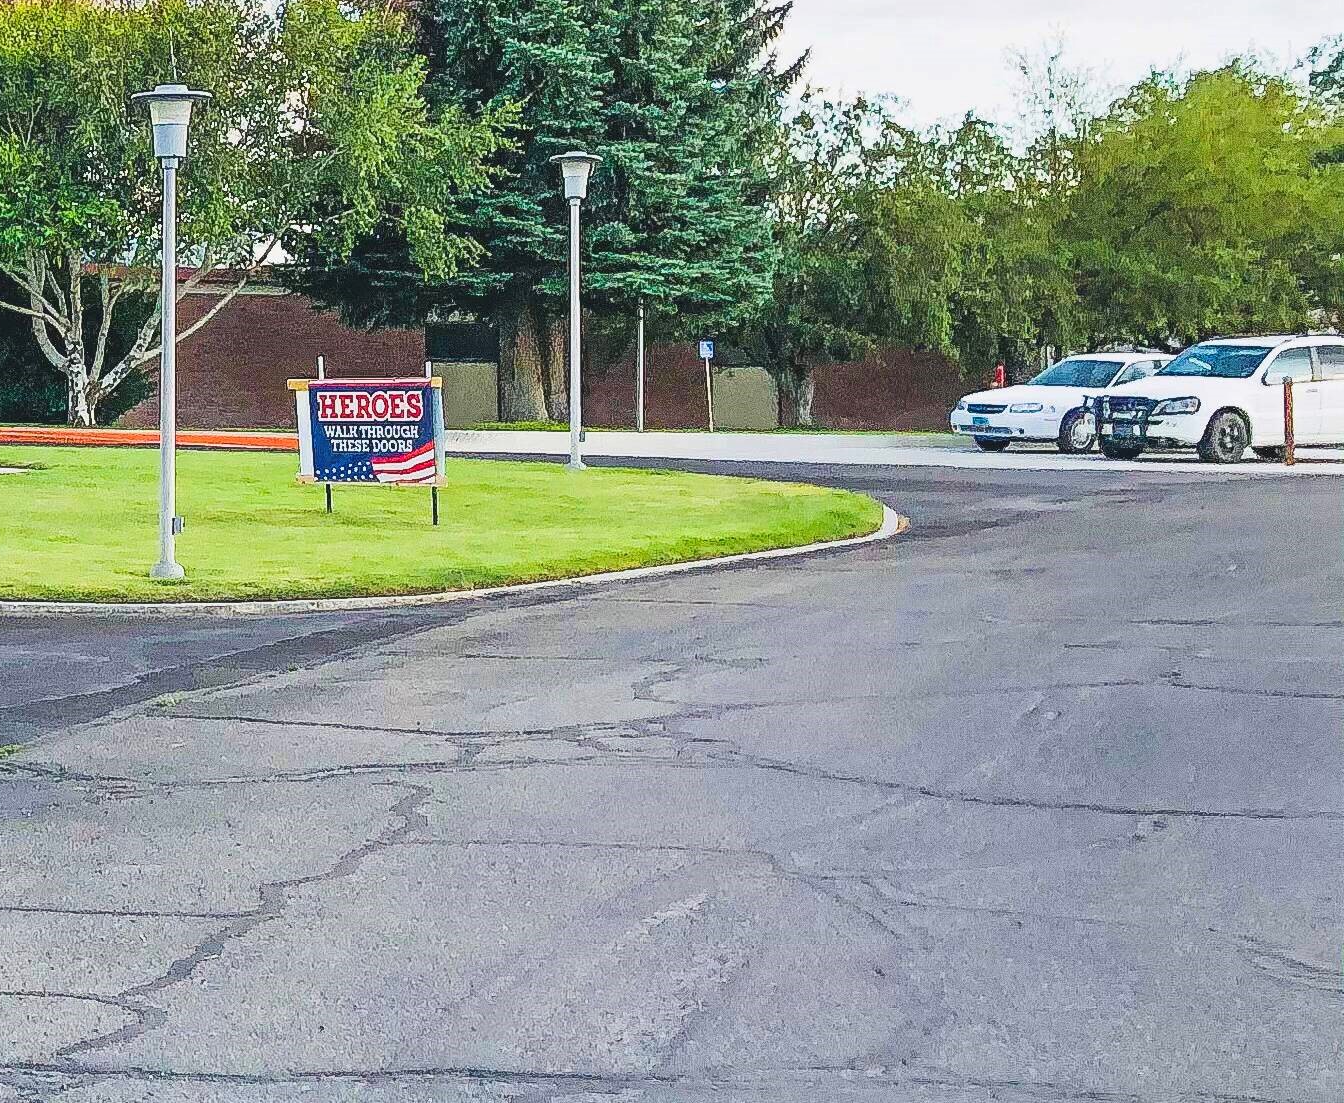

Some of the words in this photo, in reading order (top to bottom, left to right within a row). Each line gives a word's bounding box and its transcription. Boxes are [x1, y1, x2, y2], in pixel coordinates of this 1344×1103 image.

[318, 393, 422, 420] HEROES
[324, 425, 358, 438] WALK
[360, 425, 419, 439] THROUGH
[331, 439, 370, 452] THESE
[371, 439, 413, 452] DOORS
